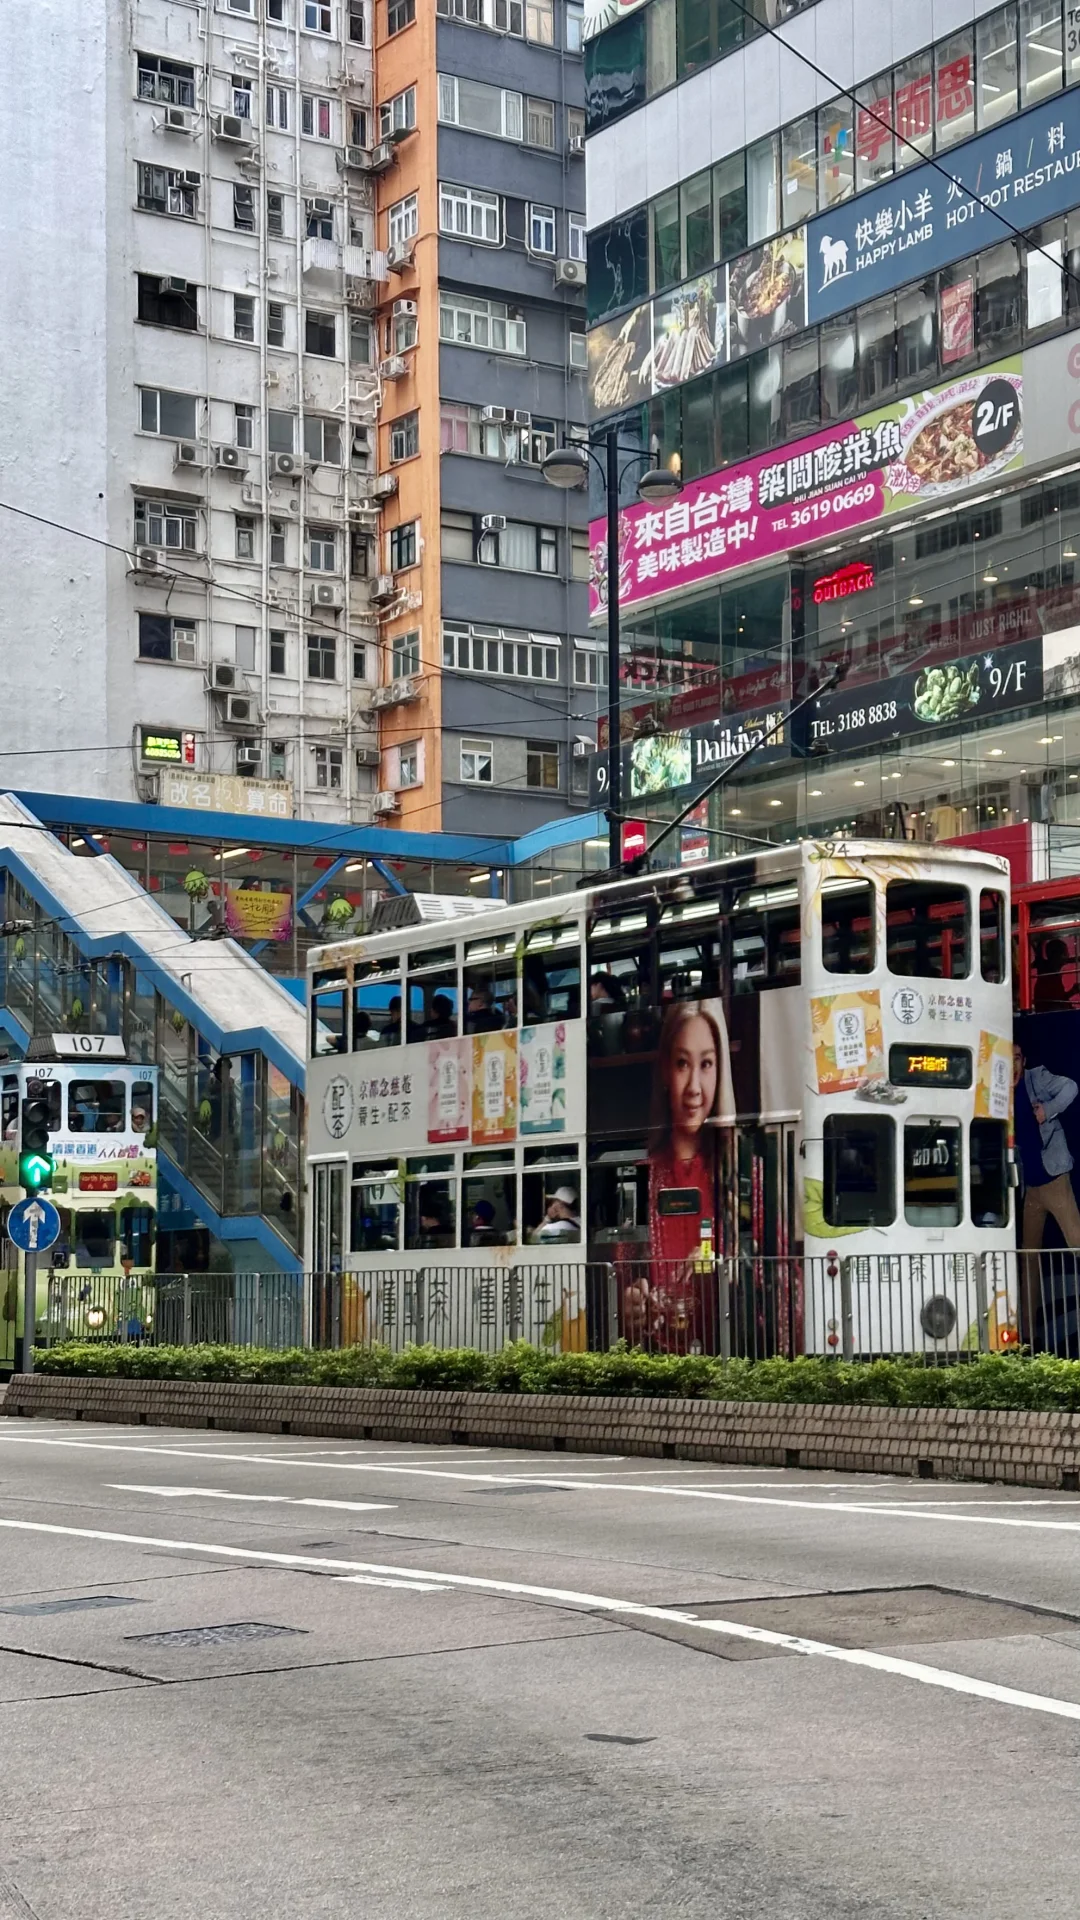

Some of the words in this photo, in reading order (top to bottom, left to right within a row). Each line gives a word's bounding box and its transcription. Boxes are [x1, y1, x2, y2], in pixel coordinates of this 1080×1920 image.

[1067, 29, 1080, 53] 3
[855, 187, 934, 252] 快樂小羊
[946, 200, 977, 230] HOT
[980, 184, 1011, 215] POT
[856, 242, 897, 273] HAPPY
[898, 222, 934, 253] LAMB
[976, 399, 1015, 438] 2/F
[758, 420, 904, 505] 築間酸菜魚
[807, 488, 824, 501] JIAN
[823, 481, 844, 496] SUAN
[844, 476, 856, 489] CAI
[856, 471, 868, 484] YU
[634, 475, 753, 549] 來自台灣
[772, 519, 788, 533] TEL
[789, 501, 831, 529] 3619
[832, 482, 876, 512] 0669
[813, 571, 875, 605] OUTBACK
[969, 615, 996, 640] JUST
[989, 660, 1027, 699] 9/F
[811, 718, 836, 739] TEL:
[837, 709, 866, 732] 3188
[868, 700, 897, 726] 8838
[170, 782, 212, 807] 改名
[246, 788, 288, 815] 算命
[824, 841, 850, 858] 94
[71, 1036, 106, 1053] 107
[34, 1068, 53, 1079] 107
[138, 1070, 153, 1081] 107
